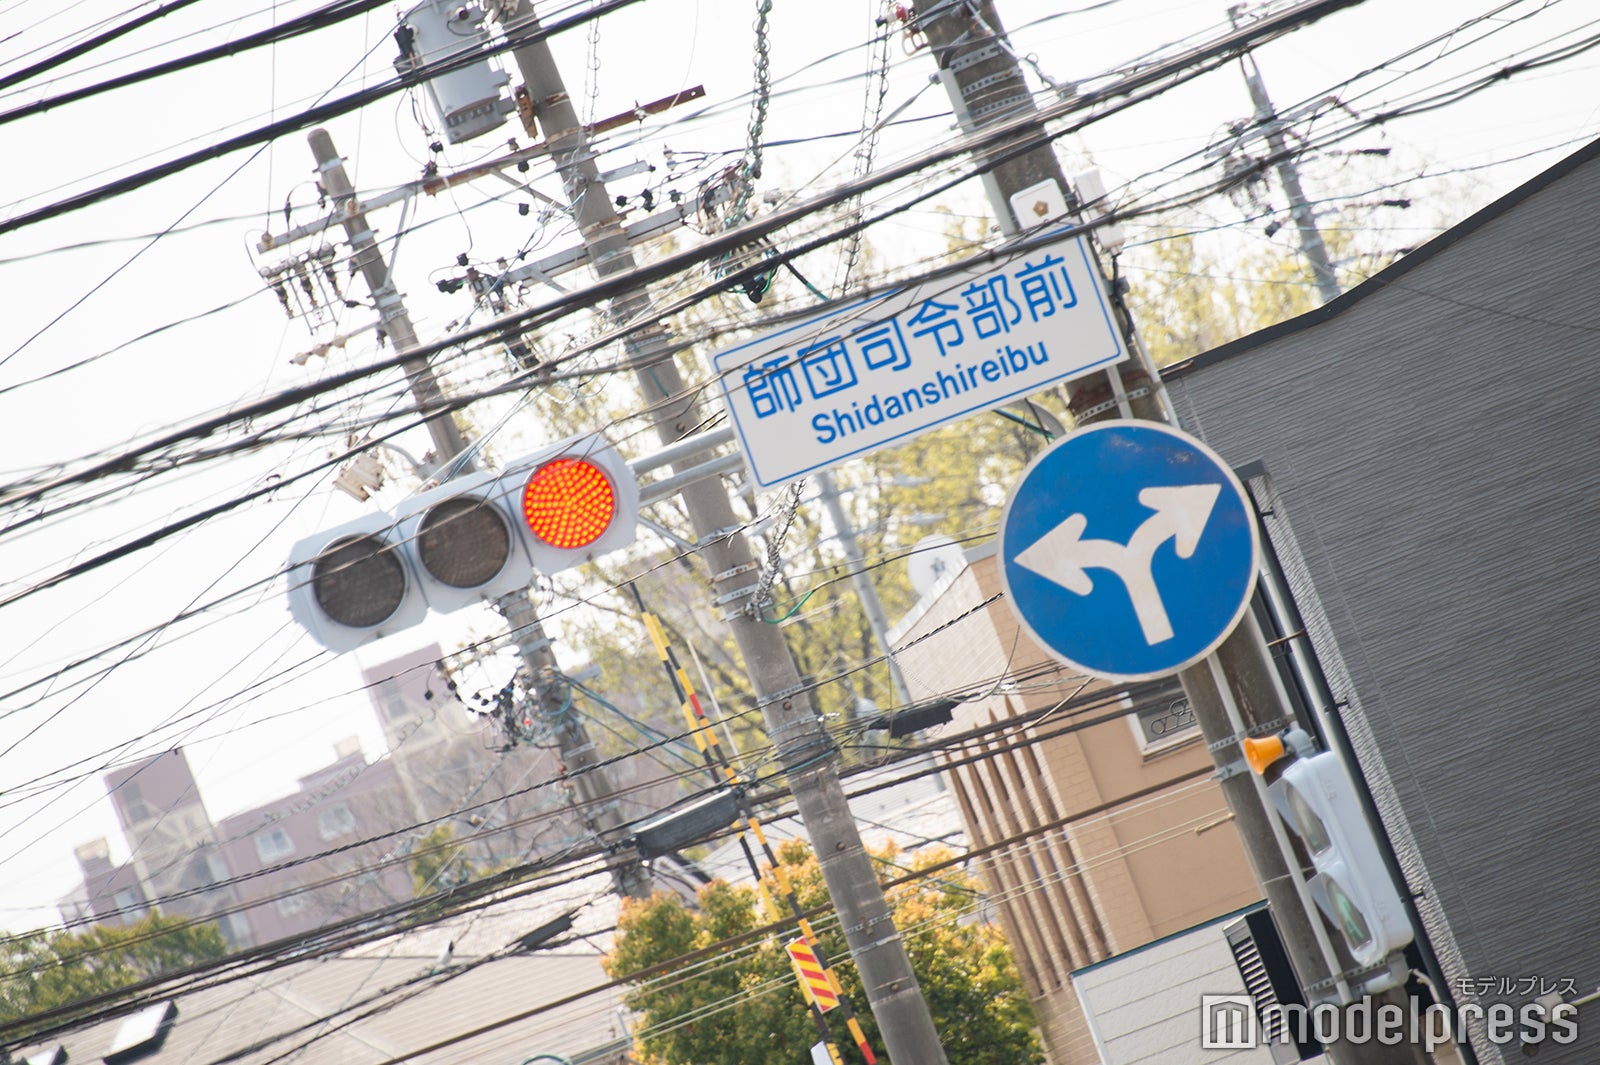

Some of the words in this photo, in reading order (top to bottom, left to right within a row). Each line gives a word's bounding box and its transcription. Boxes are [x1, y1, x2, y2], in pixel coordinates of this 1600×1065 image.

[743, 254, 1078, 419] 師団司令部前
[811, 340, 1050, 445] Shidanshireibu
